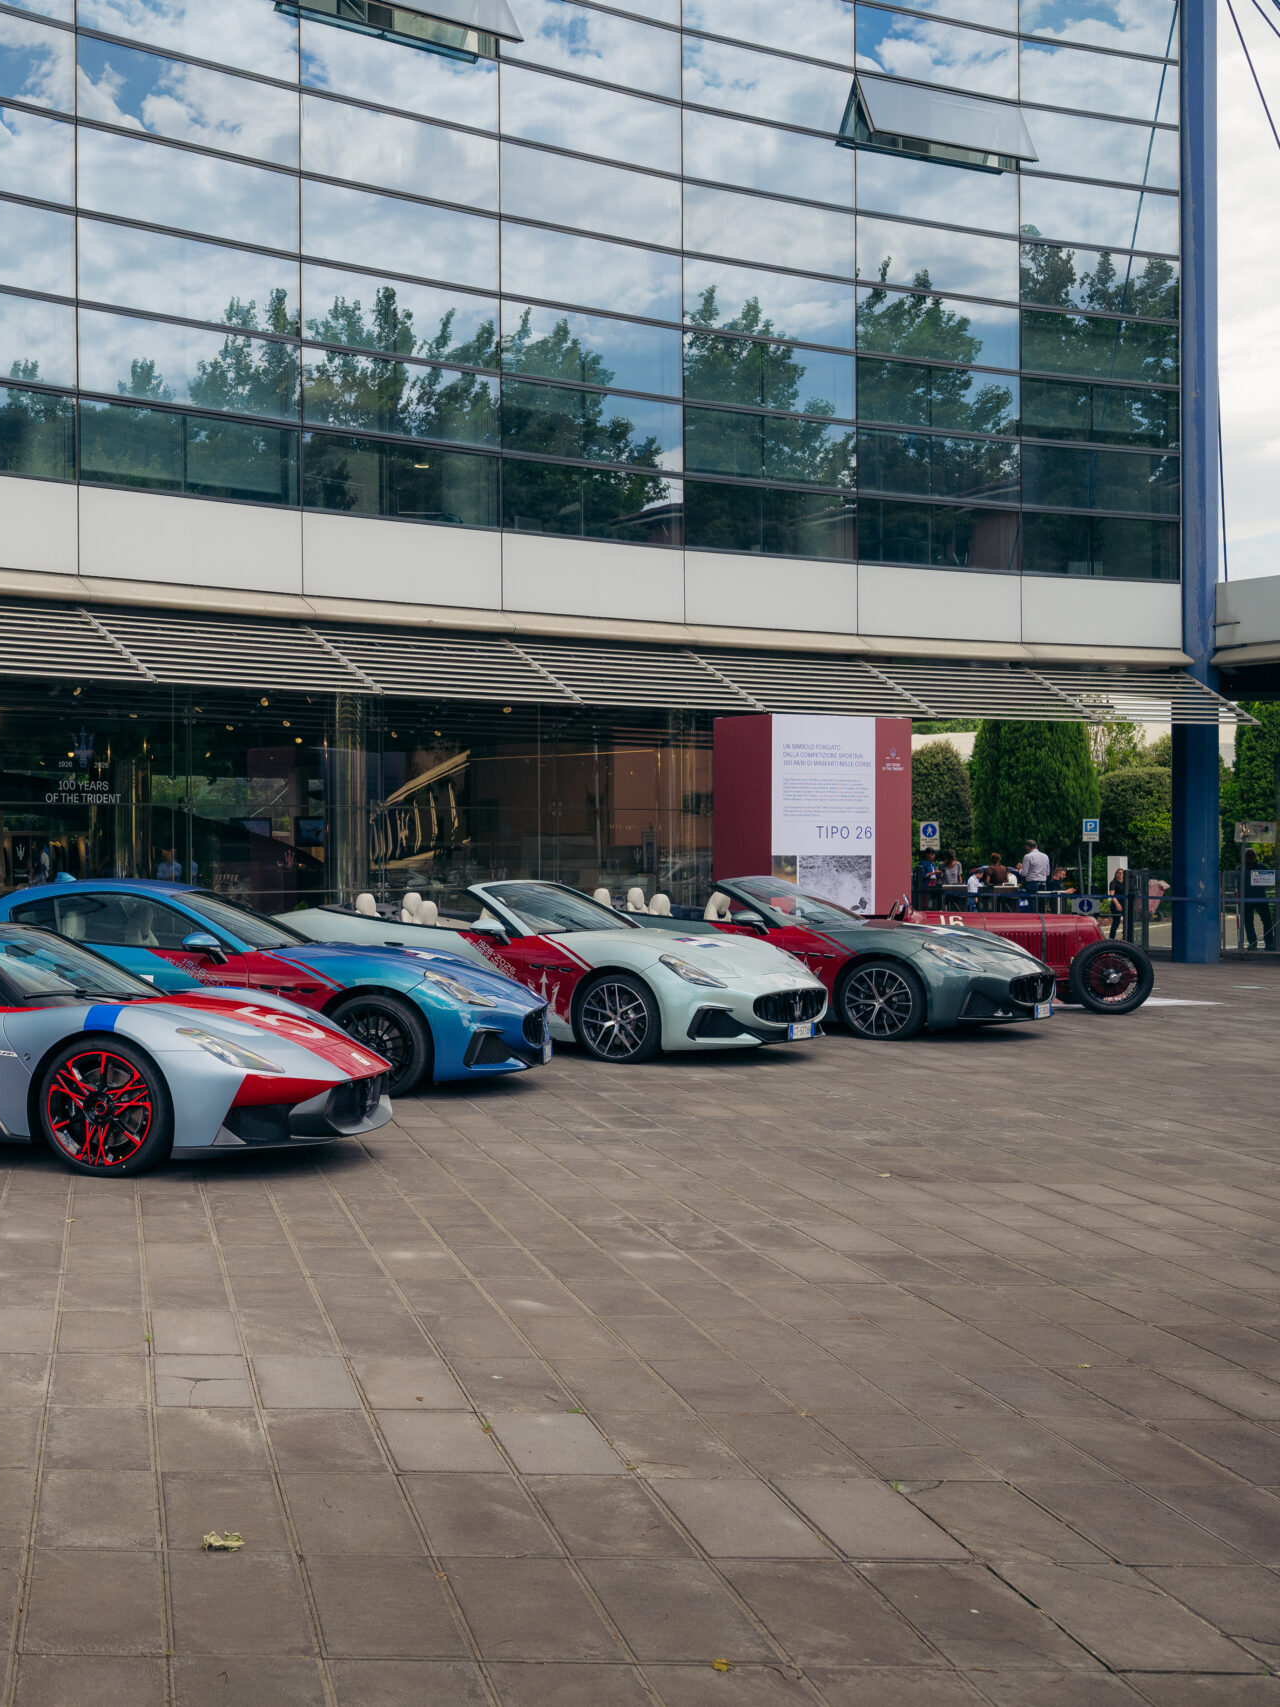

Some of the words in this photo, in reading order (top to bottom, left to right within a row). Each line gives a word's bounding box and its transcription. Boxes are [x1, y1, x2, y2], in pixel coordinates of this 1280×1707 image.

[58, 780, 76, 790] 100
[77, 780, 109, 791] YEARS
[45, 792, 59, 803] OF
[60, 793, 79, 804] THE
[80, 793, 122, 804] TRIDENT
[816, 825, 850, 840] TIPO
[855, 826, 873, 840] 26
[477, 939, 516, 975] 1926-2026
[182, 958, 230, 987] 1926-20
